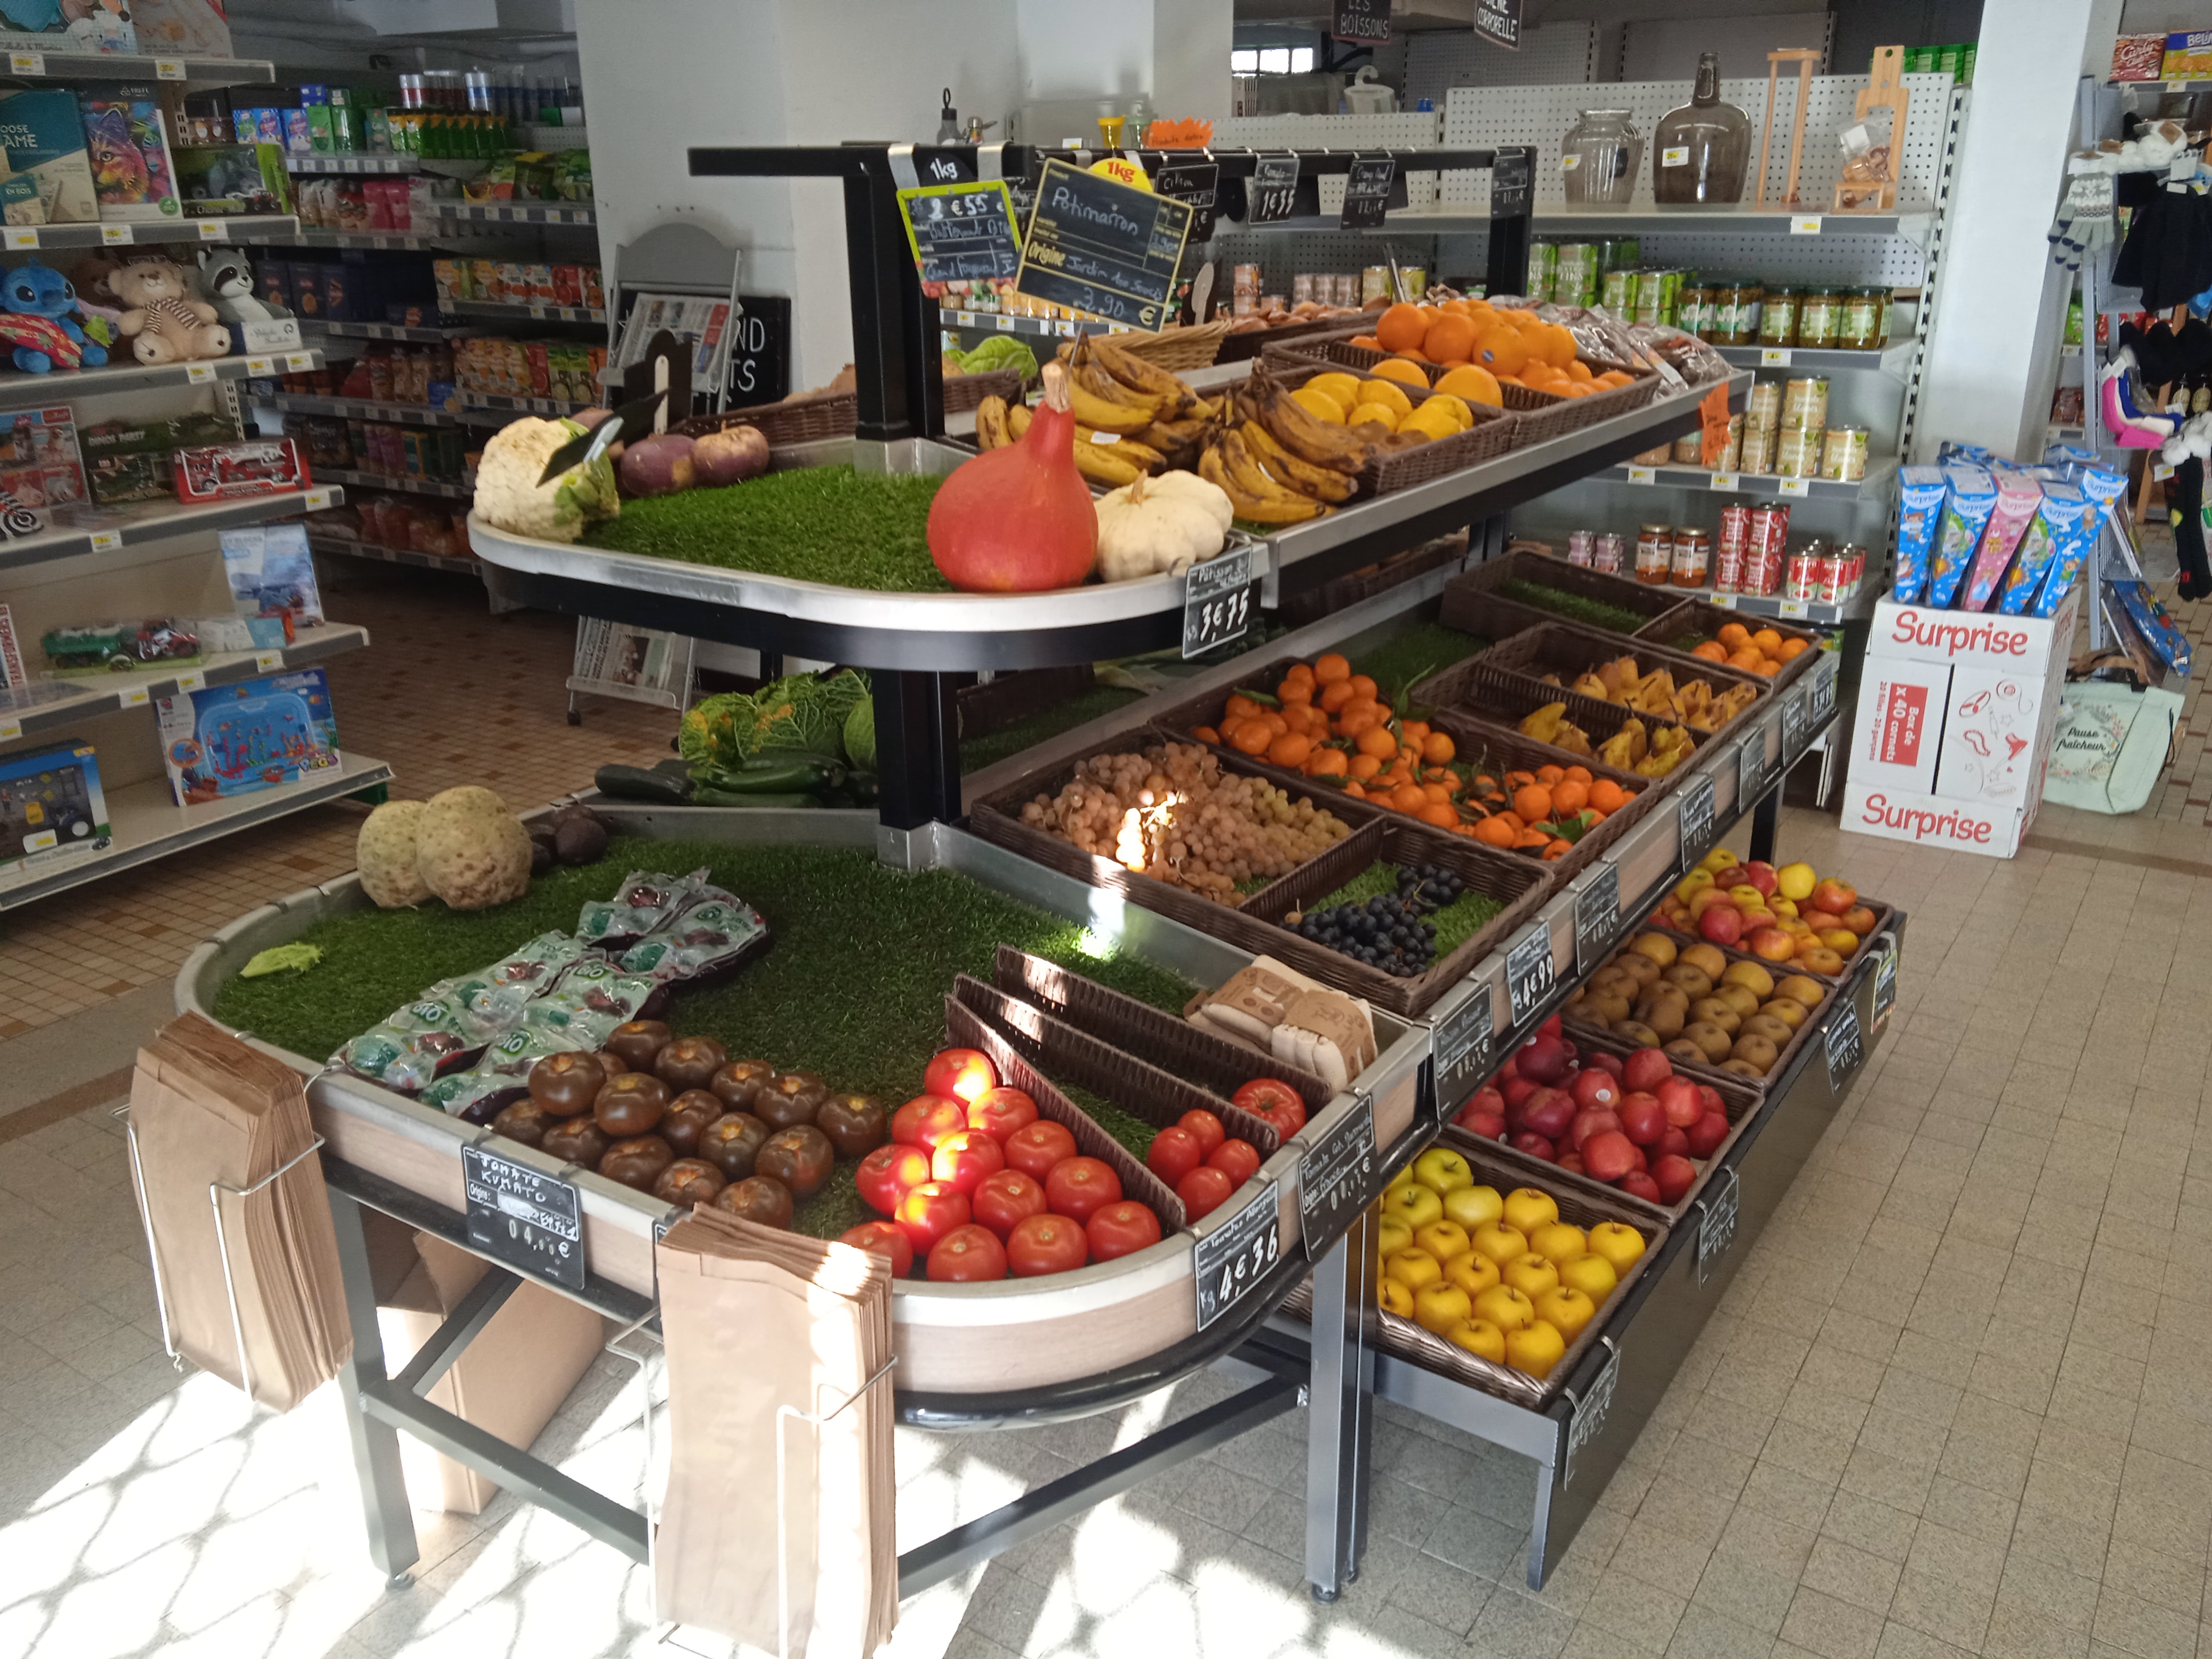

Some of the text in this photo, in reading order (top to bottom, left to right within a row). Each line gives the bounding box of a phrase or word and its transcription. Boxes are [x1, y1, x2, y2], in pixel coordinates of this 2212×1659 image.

[2121, 40, 2155, 61] Curly
[929, 157, 959, 180] 1kg
[1107, 161, 1136, 183] 1kg
[1028, 240, 1067, 267] Origine
[1905, 493, 1941, 504] Surprise
[2087, 482, 2121, 497] Surprise
[1957, 502, 1991, 513] Surprise
[2000, 497, 2036, 510] Surprise
[2046, 505, 2079, 517] Surprise
[1891, 610, 2029, 656] Surprise
[1893, 698, 1908, 719] 40
[1904, 706, 1920, 746] Box de
[2067, 726, 2099, 738] Pause
[1886, 719, 1900, 762] cornets
[1862, 792, 1993, 844] Surprise
[479, 1155, 541, 1187] TOMATE
[481, 1170, 547, 1203] KUMATO
